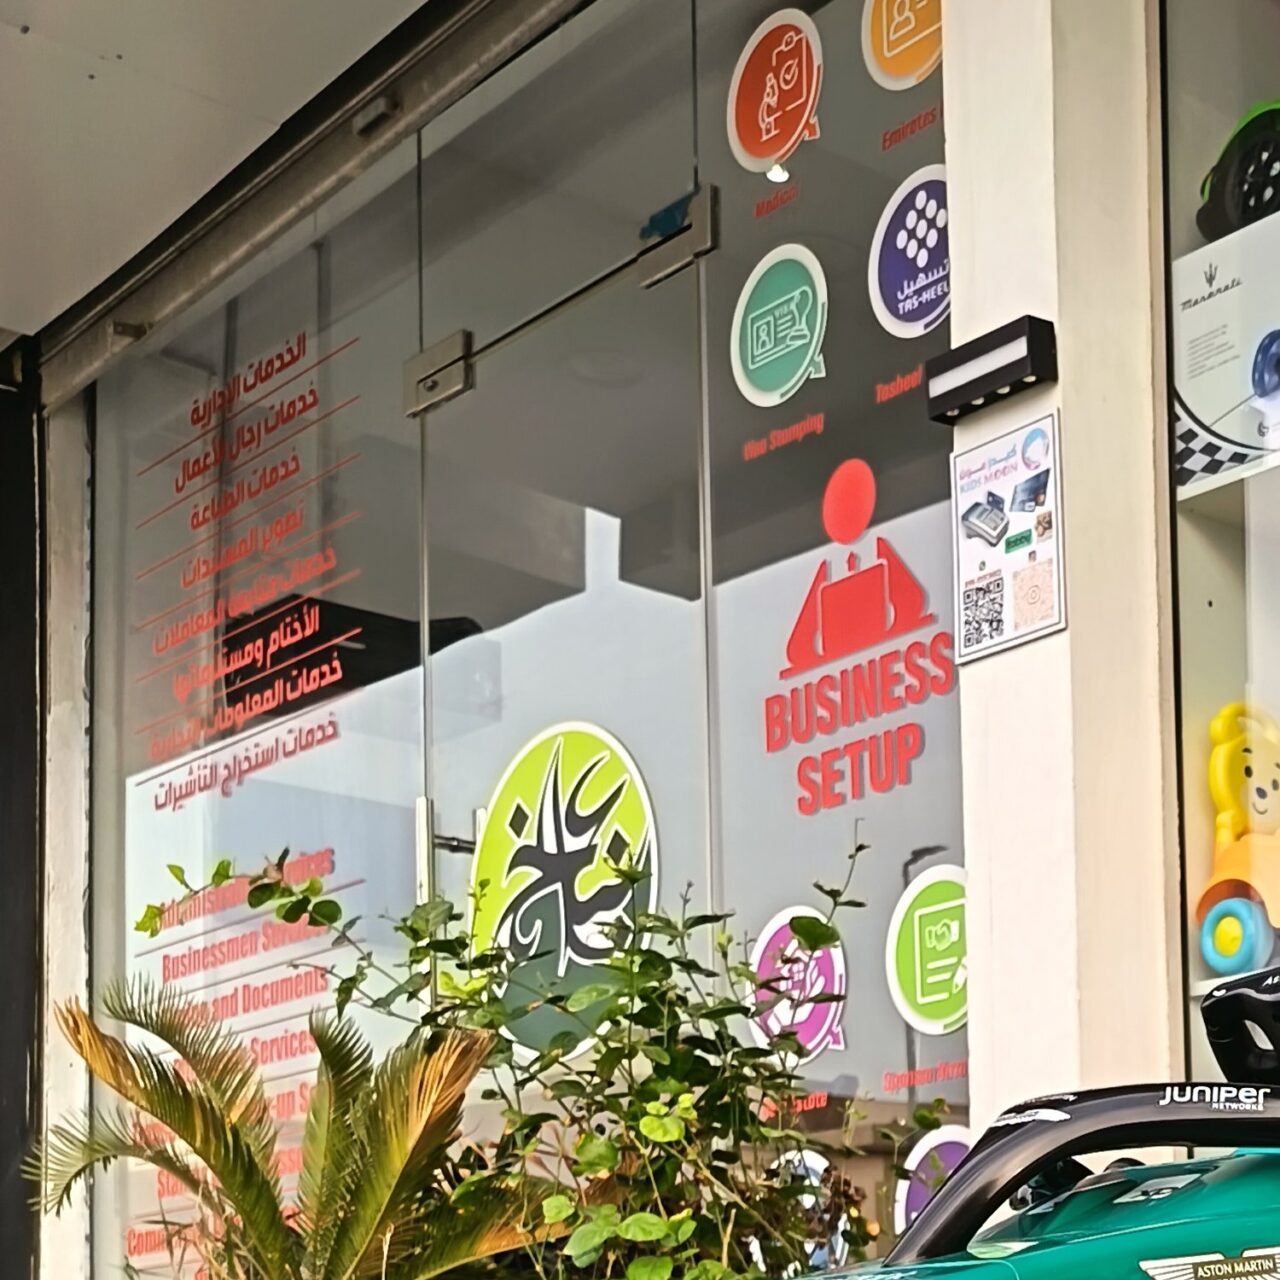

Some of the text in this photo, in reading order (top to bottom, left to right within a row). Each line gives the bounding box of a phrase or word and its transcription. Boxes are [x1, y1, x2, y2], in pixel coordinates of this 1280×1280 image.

[243, 331, 306, 394] الخدمات
[264, 384, 320, 433] خدمات
[247, 451, 301, 500] خدمات
[286, 650, 342, 698] خدمات
[764, 631, 959, 753] BUSINESS
[283, 712, 338, 758] خدمات
[796, 721, 926, 817] SETUP
[162, 931, 258, 983] Businessmen
[211, 986, 240, 1022] and
[242, 965, 329, 1014] Documents
[1196, 1258, 1275, 1279] ASTON MARTIN
